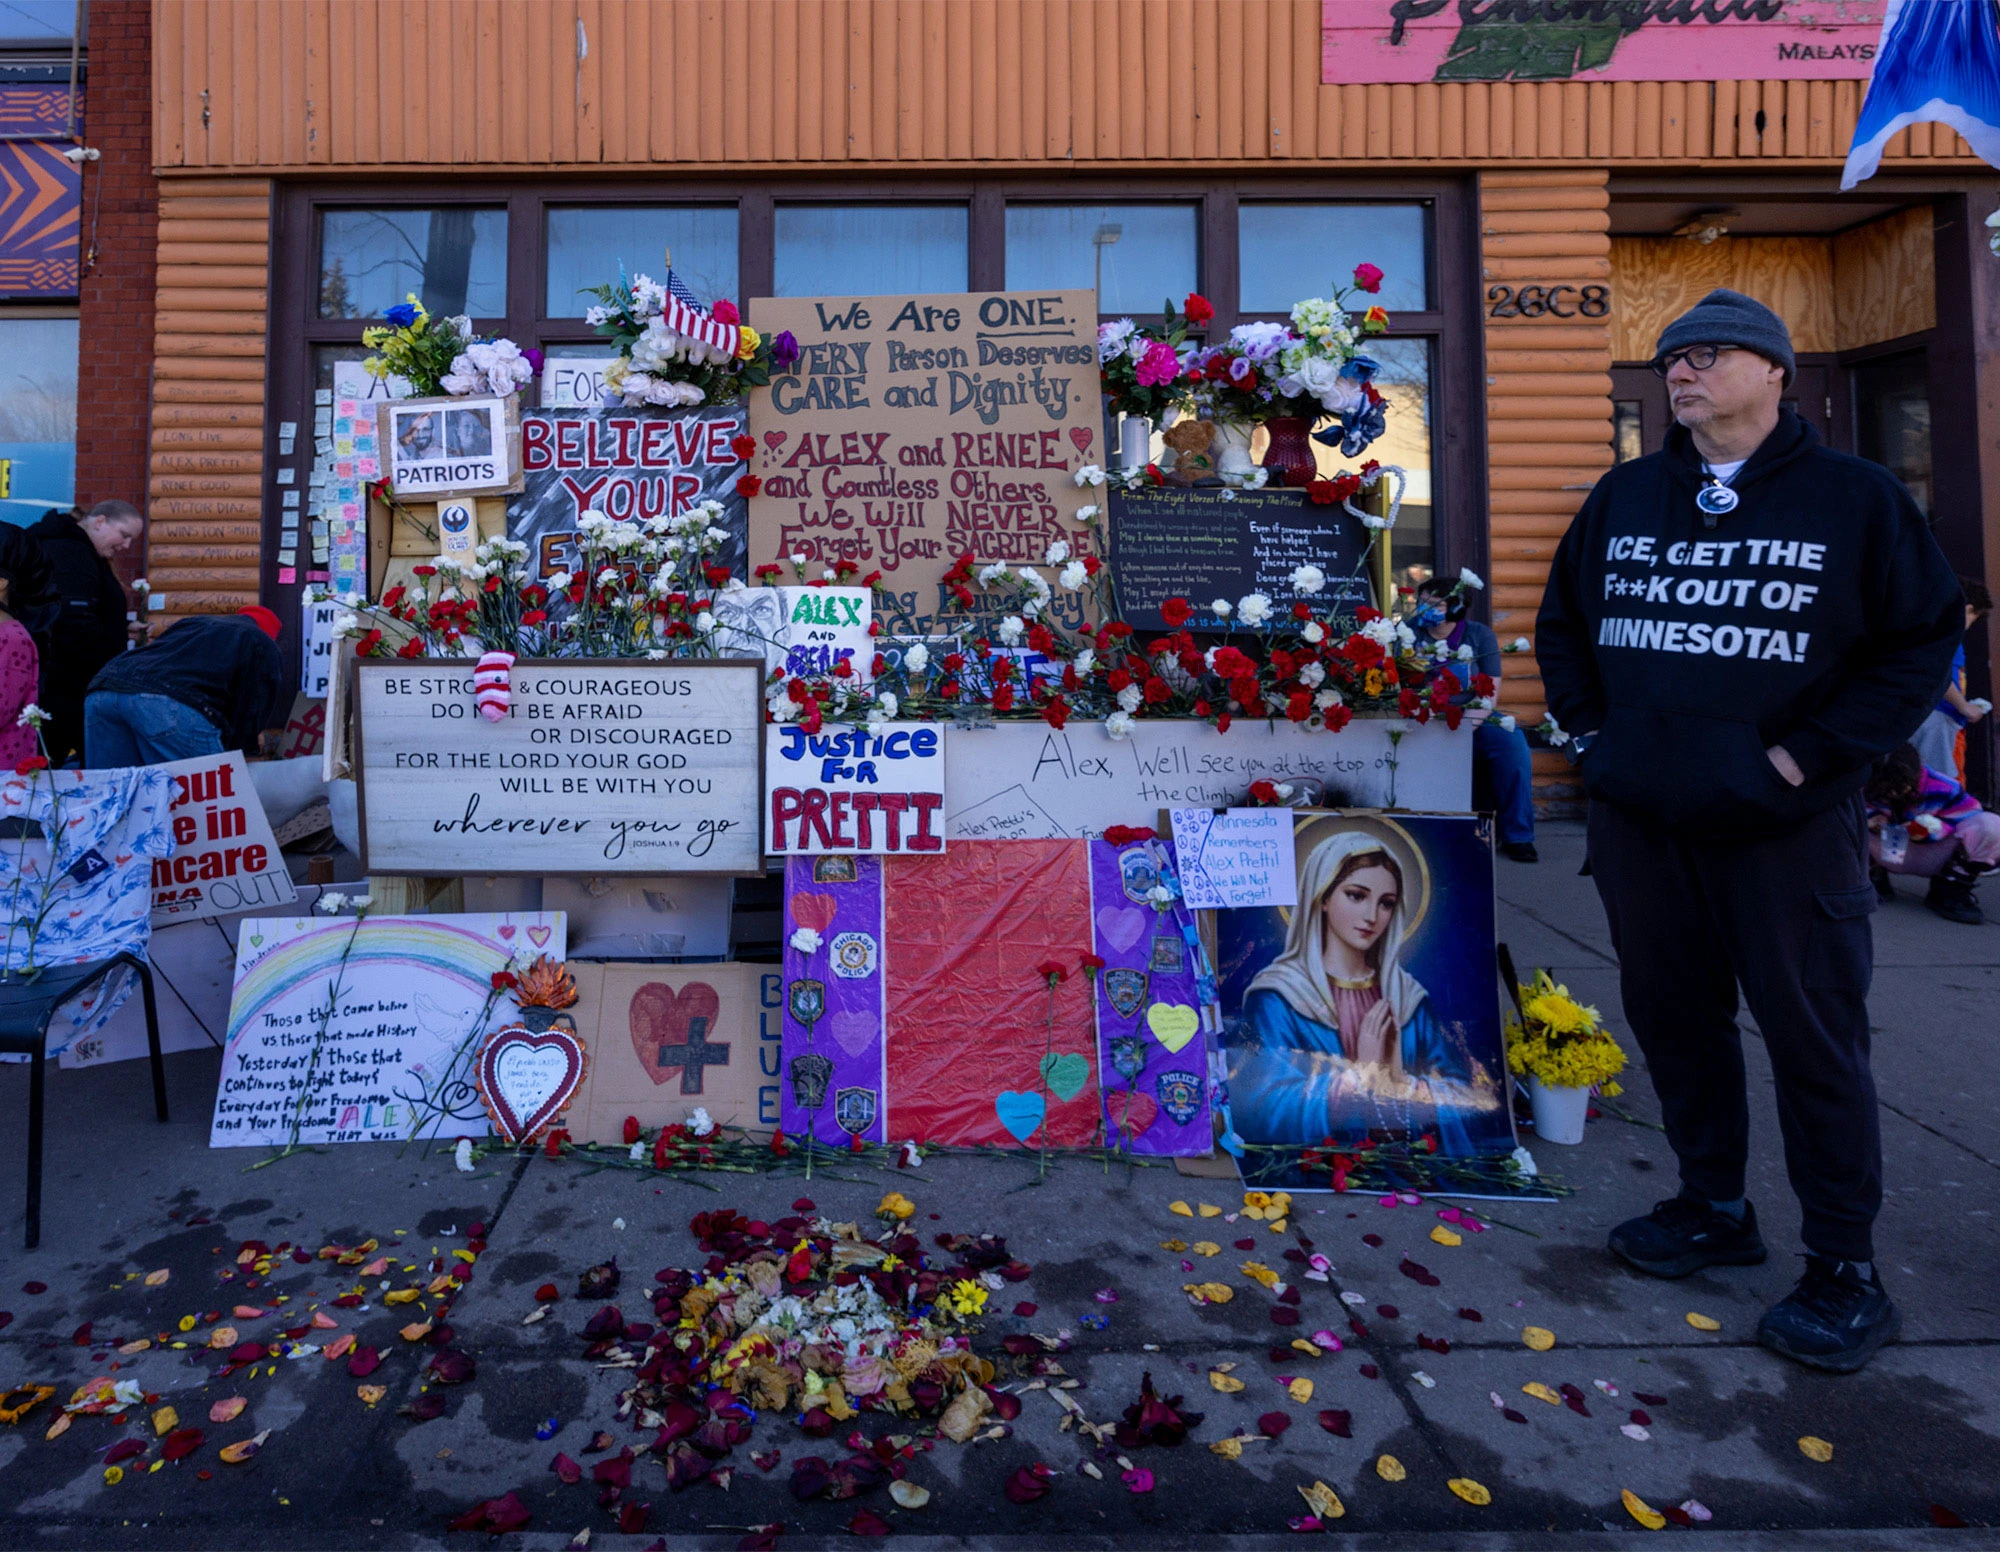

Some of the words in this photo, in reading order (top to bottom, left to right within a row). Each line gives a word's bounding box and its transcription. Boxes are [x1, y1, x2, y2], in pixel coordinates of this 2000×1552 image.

[1778, 42, 1879, 60] MALAYS
[815, 302, 872, 332] We
[887, 301, 961, 332] Are
[978, 297, 1075, 326] ONE.
[888, 341, 968, 372] Person
[978, 340, 1092, 366] Deserves
[771, 375, 871, 415] CARE
[884, 376, 937, 408] and
[947, 367, 1080, 425] Dignity.
[199, 431, 222, 442] LIVE
[522, 417, 738, 471] BELIEVE
[781, 432, 891, 468] ALEX
[899, 438, 946, 467] and
[952, 429, 1068, 471] RENEE
[397, 464, 494, 485] PATRIOTS
[764, 468, 812, 499] and
[822, 465, 938, 500] Countless
[951, 469, 1053, 503] Others,
[161, 480, 195, 491] RENEE
[200, 480, 230, 491] GOOD
[561, 475, 701, 521] YOUR
[1121, 490, 1144, 500] From
[1148, 490, 1162, 501] The
[1163, 492, 1186, 506] Eight
[1189, 493, 1214, 503] Verses
[169, 502, 212, 514] VICTOR
[217, 502, 244, 514] DIAZ
[798, 500, 854, 530] We
[862, 501, 926, 528] Will
[946, 501, 1066, 533] NEVER
[1249, 521, 1271, 533] Even
[775, 524, 874, 569] Forget
[877, 527, 943, 571] Your
[1253, 546, 1270, 557] And
[1316, 547, 1338, 558] have
[1606, 535, 1659, 567] ICE,
[1666, 541, 1741, 567] GET
[1746, 538, 1827, 572] THE
[1675, 578, 1756, 608] OUT
[1760, 580, 1819, 613] OF
[791, 593, 864, 627] ALEX
[807, 630, 836, 641] AND
[1598, 617, 1811, 663] MINNESOTA!
[385, 679, 412, 695] BE
[420, 679, 476, 695] STRO
[519, 681, 531, 694] &
[535, 679, 692, 696] COURAGEOUS
[432, 703, 464, 719] DO
[473, 703, 519, 719] NT
[528, 704, 555, 719] BE
[562, 704, 643, 719] AFRAID
[530, 728, 562, 745] OR
[570, 728, 732, 745] DISCOURAGED
[780, 727, 938, 761] Justice
[396, 753, 440, 769] FOR
[447, 753, 491, 769] THE
[499, 753, 559, 769] LORD
[566, 753, 630, 769] YOUR
[637, 754, 687, 770] GOD
[1032, 733, 1113, 782] Alex,
[1197, 754, 1235, 773] see
[1240, 756, 1266, 787] you
[1273, 753, 1294, 775] at
[1298, 753, 1326, 774] the
[1333, 752, 1365, 776] top
[500, 777, 554, 794] WILL
[562, 777, 590, 794] BE
[596, 777, 656, 794] WITH
[664, 777, 712, 794] YOU
[1137, 781, 1181, 802] the
[1185, 786, 1234, 804] Climb
[206, 805, 247, 841] in
[433, 793, 591, 835] wherever
[604, 818, 681, 860] you
[687, 818, 739, 858] go
[772, 787, 942, 850] PRETTI
[1215, 812, 1278, 829] Minnesota
[956, 821, 988, 837] Alex
[633, 840, 666, 848] JOSHUA
[1207, 833, 1278, 849] Remembers
[1206, 854, 1235, 870] Alex
[1214, 876, 1229, 887] We
[1249, 872, 1269, 885] Not
[210, 869, 297, 910] OUT!
[1230, 887, 1272, 904] Forget!
[834, 933, 873, 951] CHICAGO
[836, 963, 870, 977] POLICE
[262, 1013, 302, 1027] Those
[309, 1007, 338, 1024] that
[378, 1000, 408, 1012] before
[280, 1033, 311, 1047] those
[314, 1031, 343, 1044] that
[346, 1029, 374, 1041] made
[377, 1024, 417, 1037] History
[237, 1053, 309, 1071] Yesterday
[327, 1048, 368, 1065] those
[371, 1047, 402, 1065] that
[1161, 1073, 1200, 1086] POLICE
[219, 1098, 281, 1113] Everyday
[216, 1117, 242, 1129] and
[337, 1104, 424, 1129] ALEX
[326, 1131, 362, 1141] THAT
